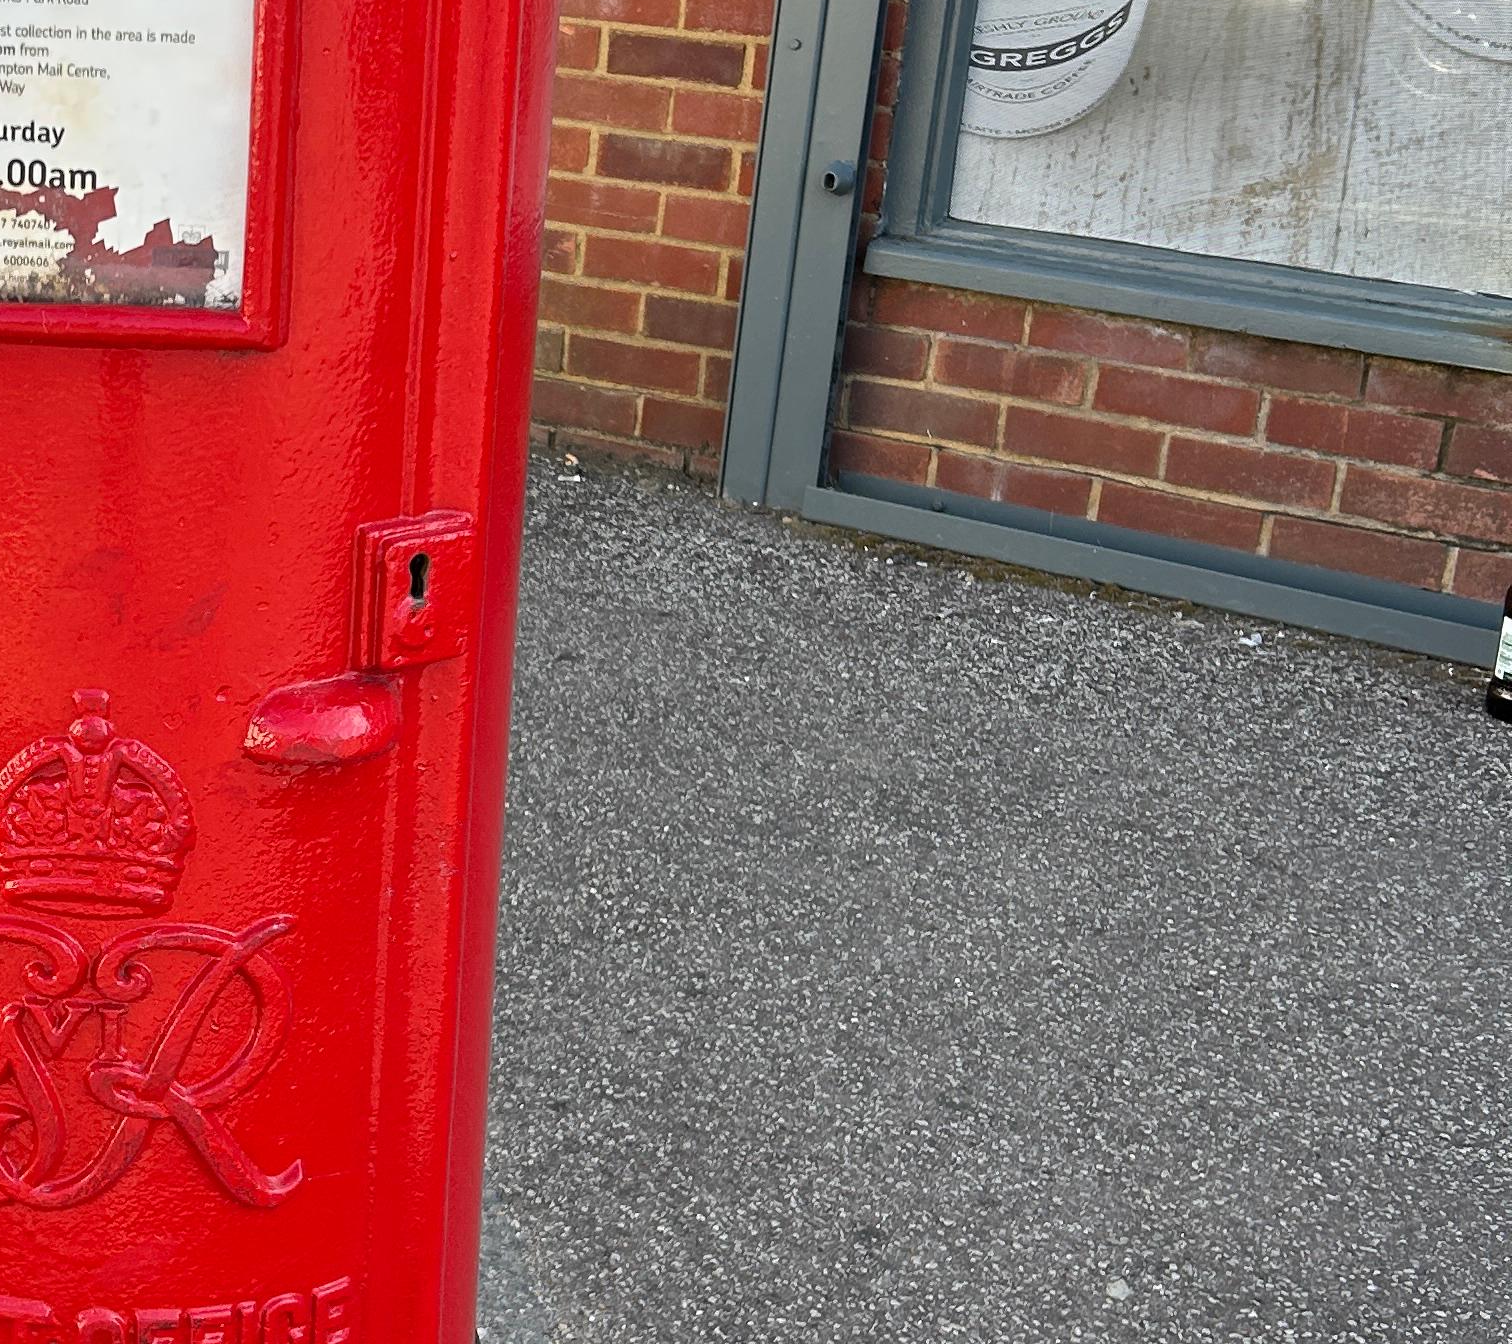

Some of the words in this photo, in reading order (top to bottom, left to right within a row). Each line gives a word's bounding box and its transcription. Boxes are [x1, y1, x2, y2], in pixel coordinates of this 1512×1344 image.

[15, 24, 72, 40] collection
[76, 26, 87, 41] in
[91, 26, 111, 42] the
[115, 30, 143, 43] area
[146, 28, 156, 43] is
[160, 29, 196, 45] made
[970, 11, 1125, 67] GREGGS
[19, 42, 49, 58] from
[37, 62, 63, 78] Mail
[66, 63, 111, 80] Centre,
[0, 80, 25, 96] Way
[3, 256, 50, 268] 6000606
